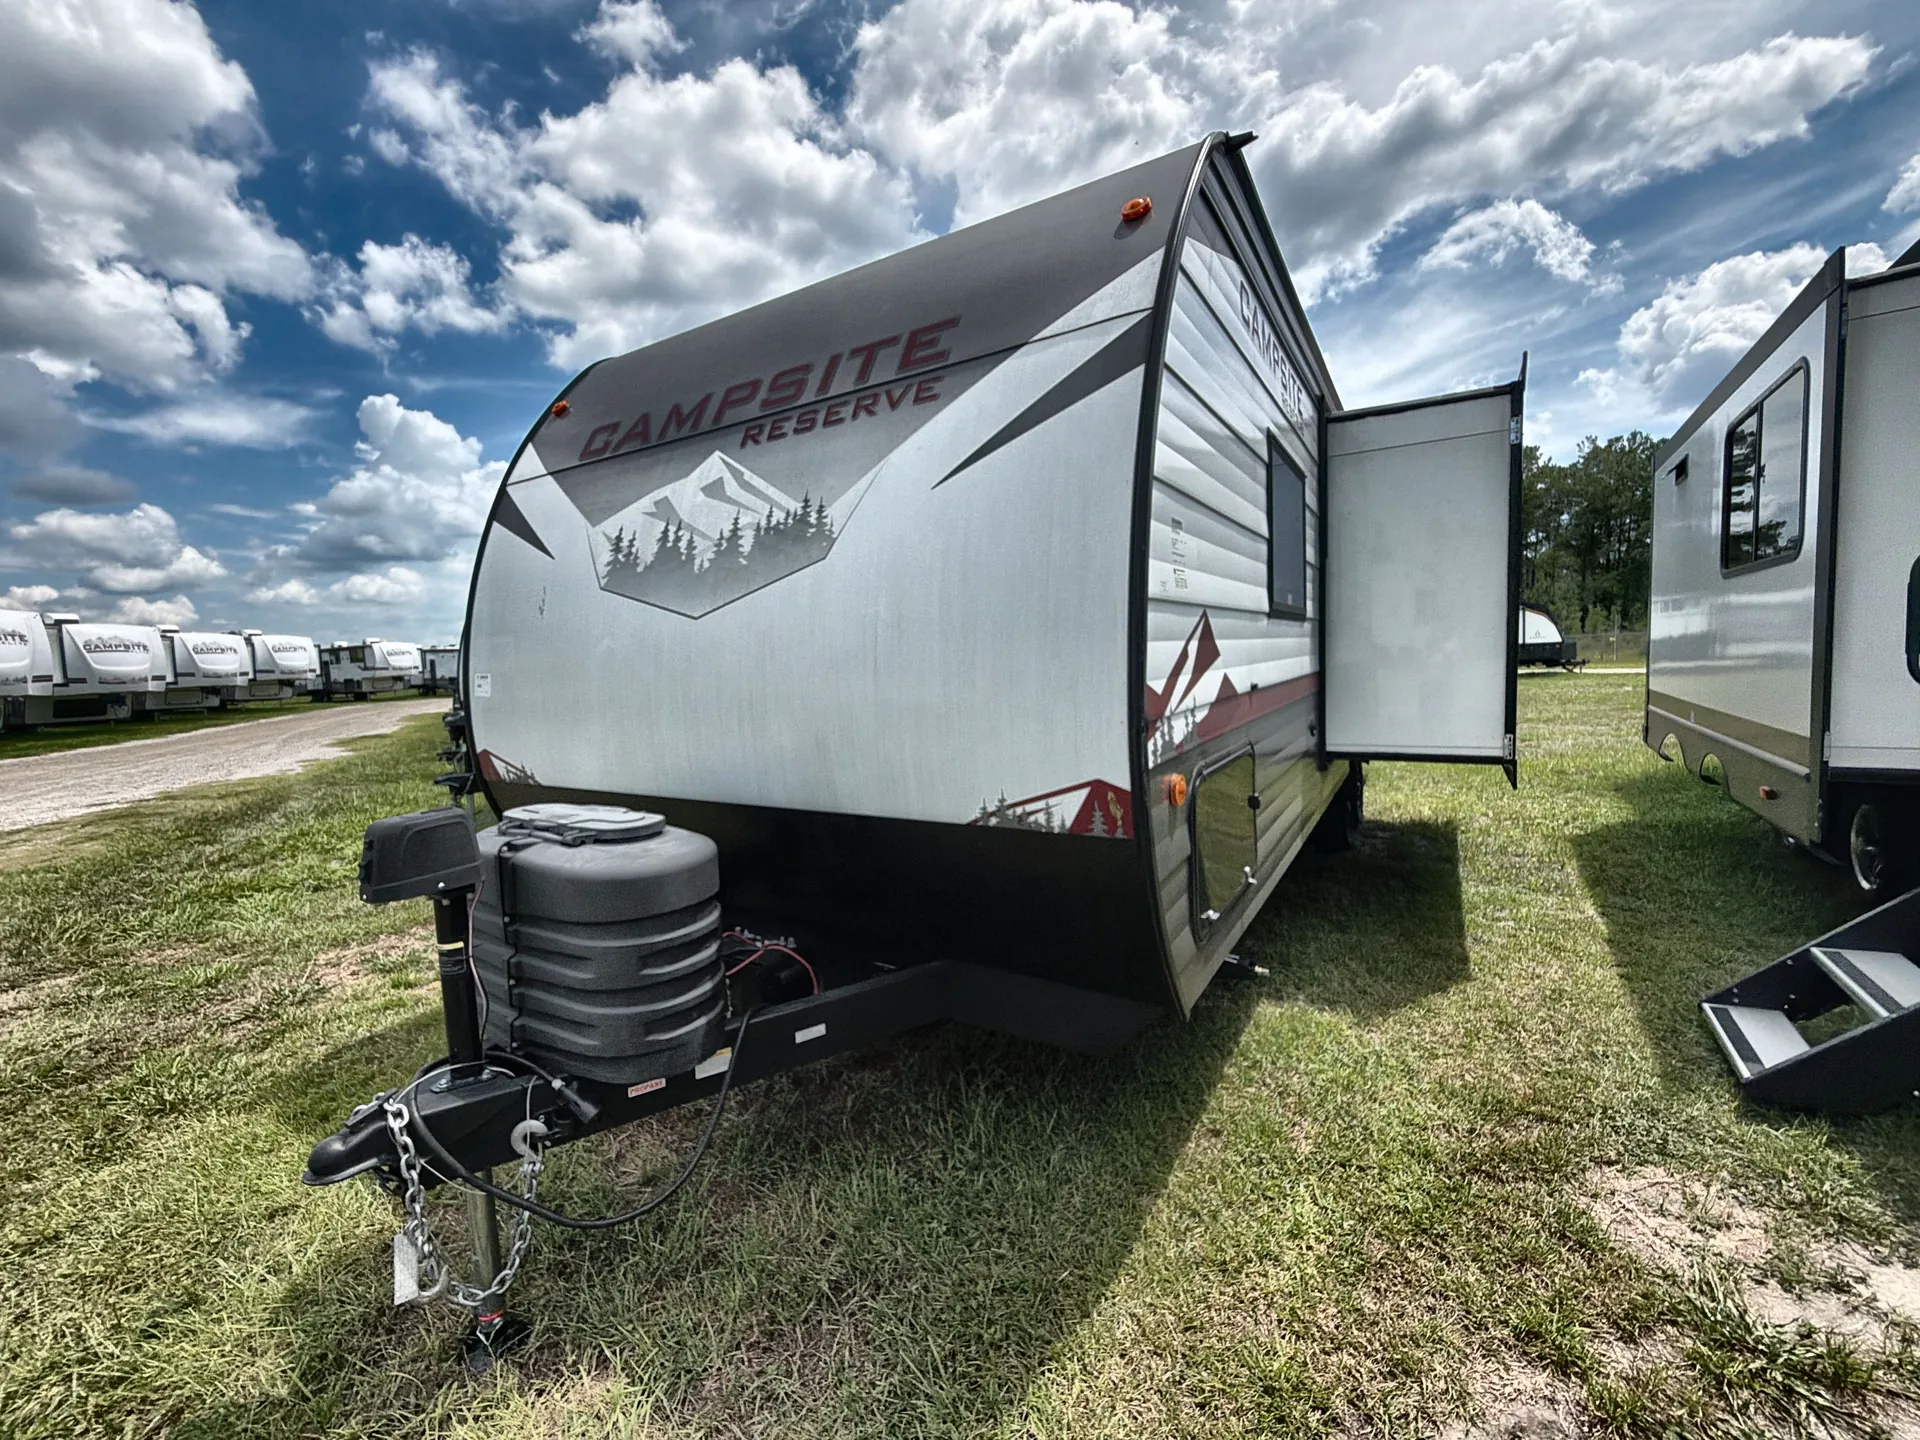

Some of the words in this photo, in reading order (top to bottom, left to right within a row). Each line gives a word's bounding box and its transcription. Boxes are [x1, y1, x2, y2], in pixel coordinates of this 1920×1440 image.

[578, 317, 960, 461] CAMPSITE
[1240, 280, 1303, 417] CAMPSITE
[740, 376, 943, 449] RESERVE
[83, 643, 149, 651] CAMPSITE
